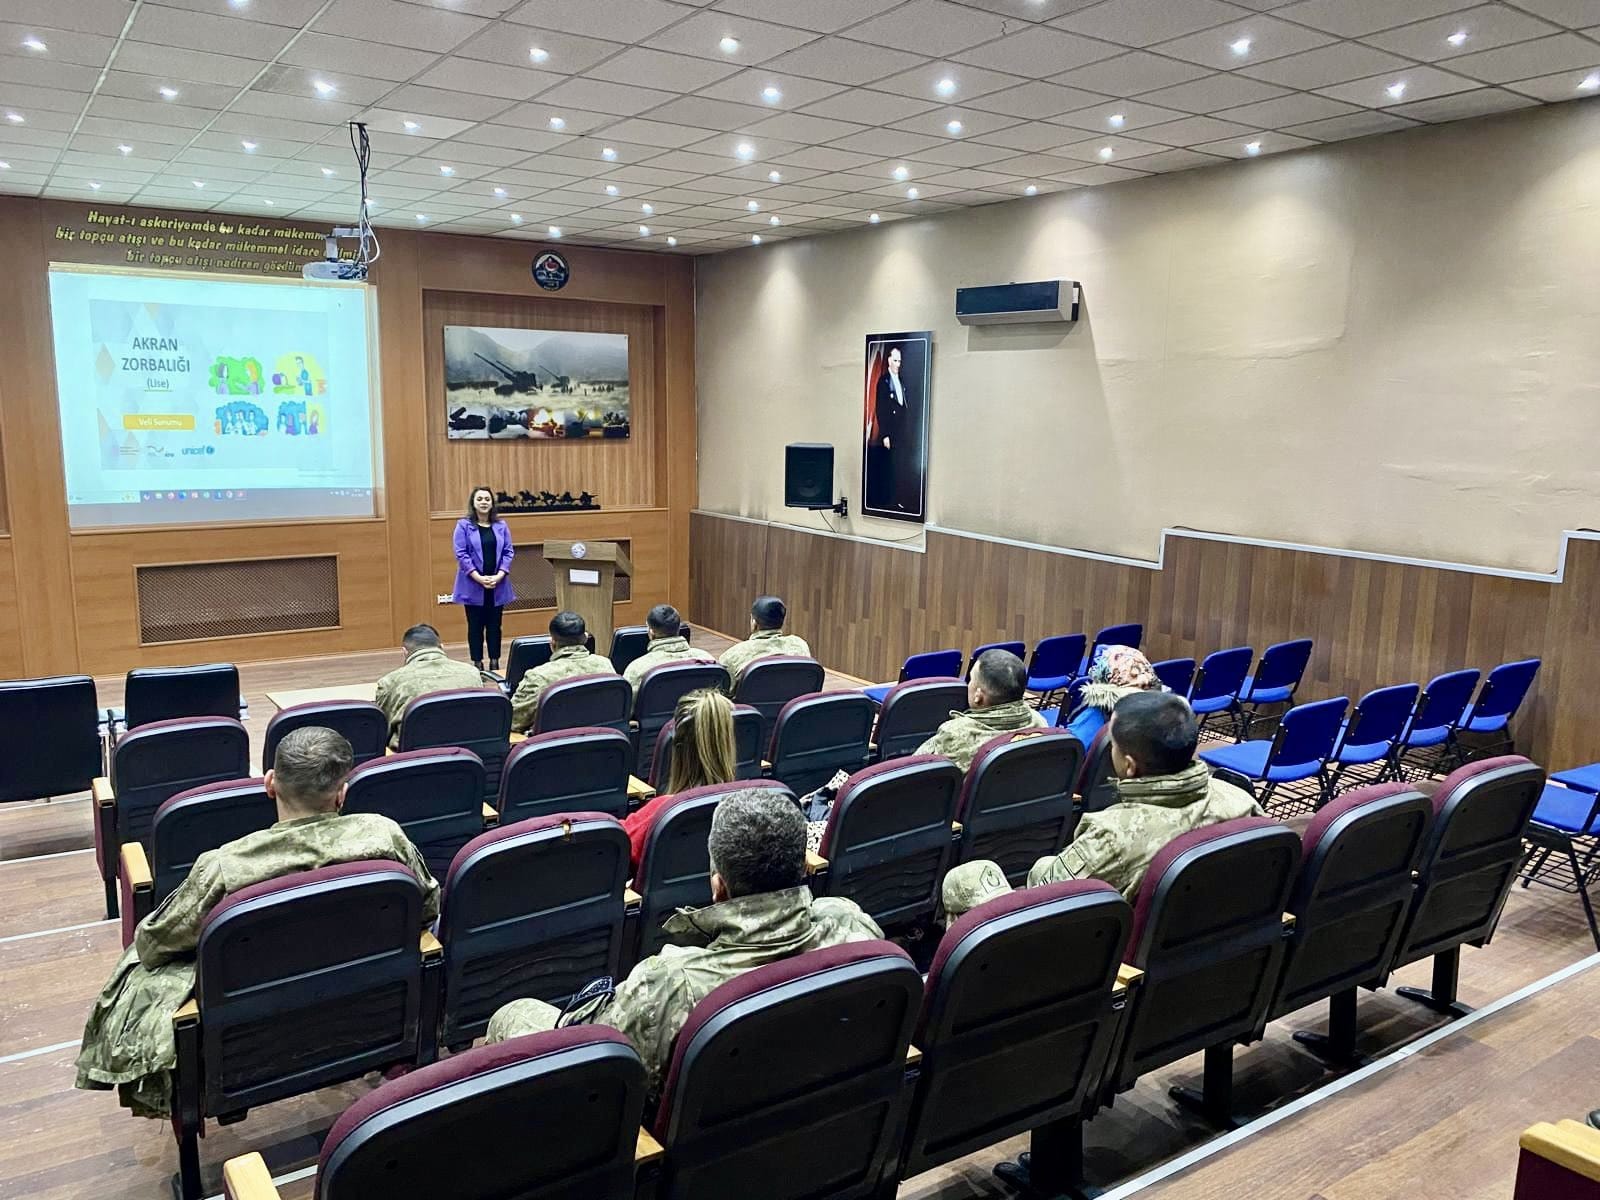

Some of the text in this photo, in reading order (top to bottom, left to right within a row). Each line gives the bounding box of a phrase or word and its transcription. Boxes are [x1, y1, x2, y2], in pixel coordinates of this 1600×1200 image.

[140, 216, 216, 232] askeriyemde
[219, 222, 234, 234] bu
[238, 224, 270, 235] kadar
[274, 227, 324, 240] mükemm
[55, 226, 75, 240] bir
[80, 230, 114, 244] topçu
[151, 237, 165, 246] ve
[169, 235, 184, 247] bu
[188, 237, 221, 250] kadar
[225, 240, 288, 254] mükemmel
[292, 245, 320, 257] idare
[127, 250, 145, 262] bir
[150, 253, 182, 267] topçu
[216, 257, 260, 269] nadiren
[132, 337, 178, 351] AKRAN
[121, 356, 190, 372] ZORBALIĞI
[147, 377, 170, 389] (Lise)
[181, 445, 206, 455] unicef
